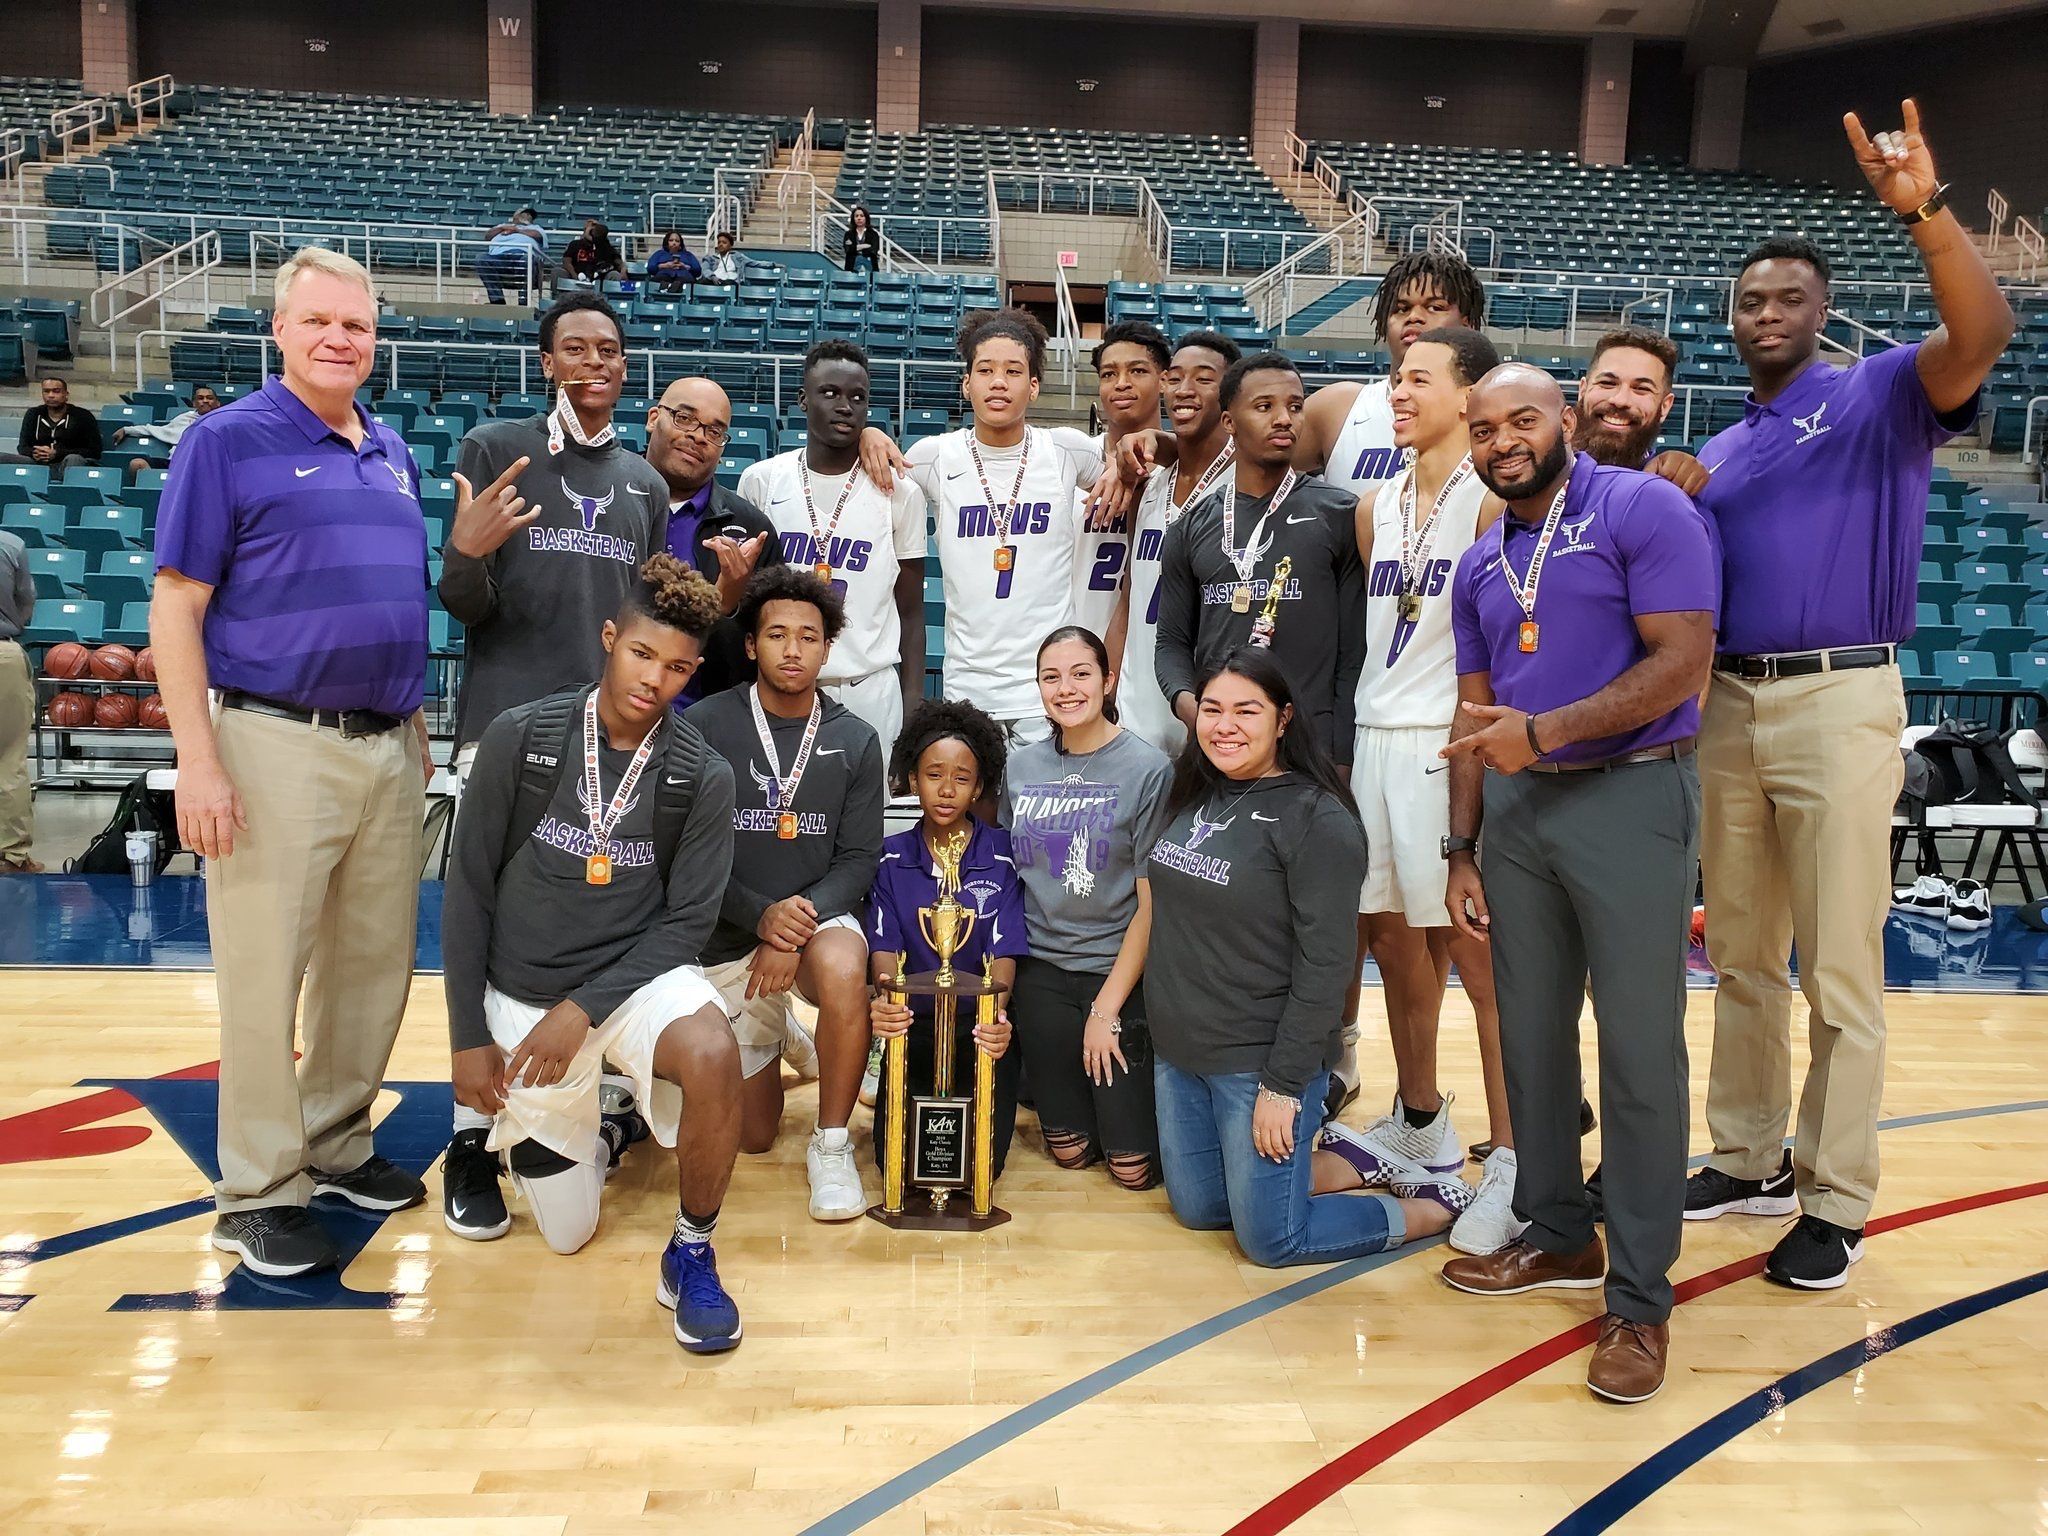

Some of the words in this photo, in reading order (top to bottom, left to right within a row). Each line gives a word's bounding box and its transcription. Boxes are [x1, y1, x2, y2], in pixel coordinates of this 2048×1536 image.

[499, 17, 521, 37] W
[309, 43, 326, 51] 206
[1079, 83, 1096, 91] 207
[1958, 451, 1979, 463] 109
[1088, 542, 1127, 592] 2
[1527, 546, 1547, 589] BASKETBALL
[1552, 542, 1596, 557] BASKETBALL
[586, 711, 596, 753] BASKETBALL
[796, 736, 813, 770] BASKETBALL
[587, 766, 600, 810] BASKETBALL
[619, 760, 644, 800] BASKETBALL
[1011, 795, 1118, 833] PLAYOFFS
[1149, 838, 1231, 886] ASKETBALL
